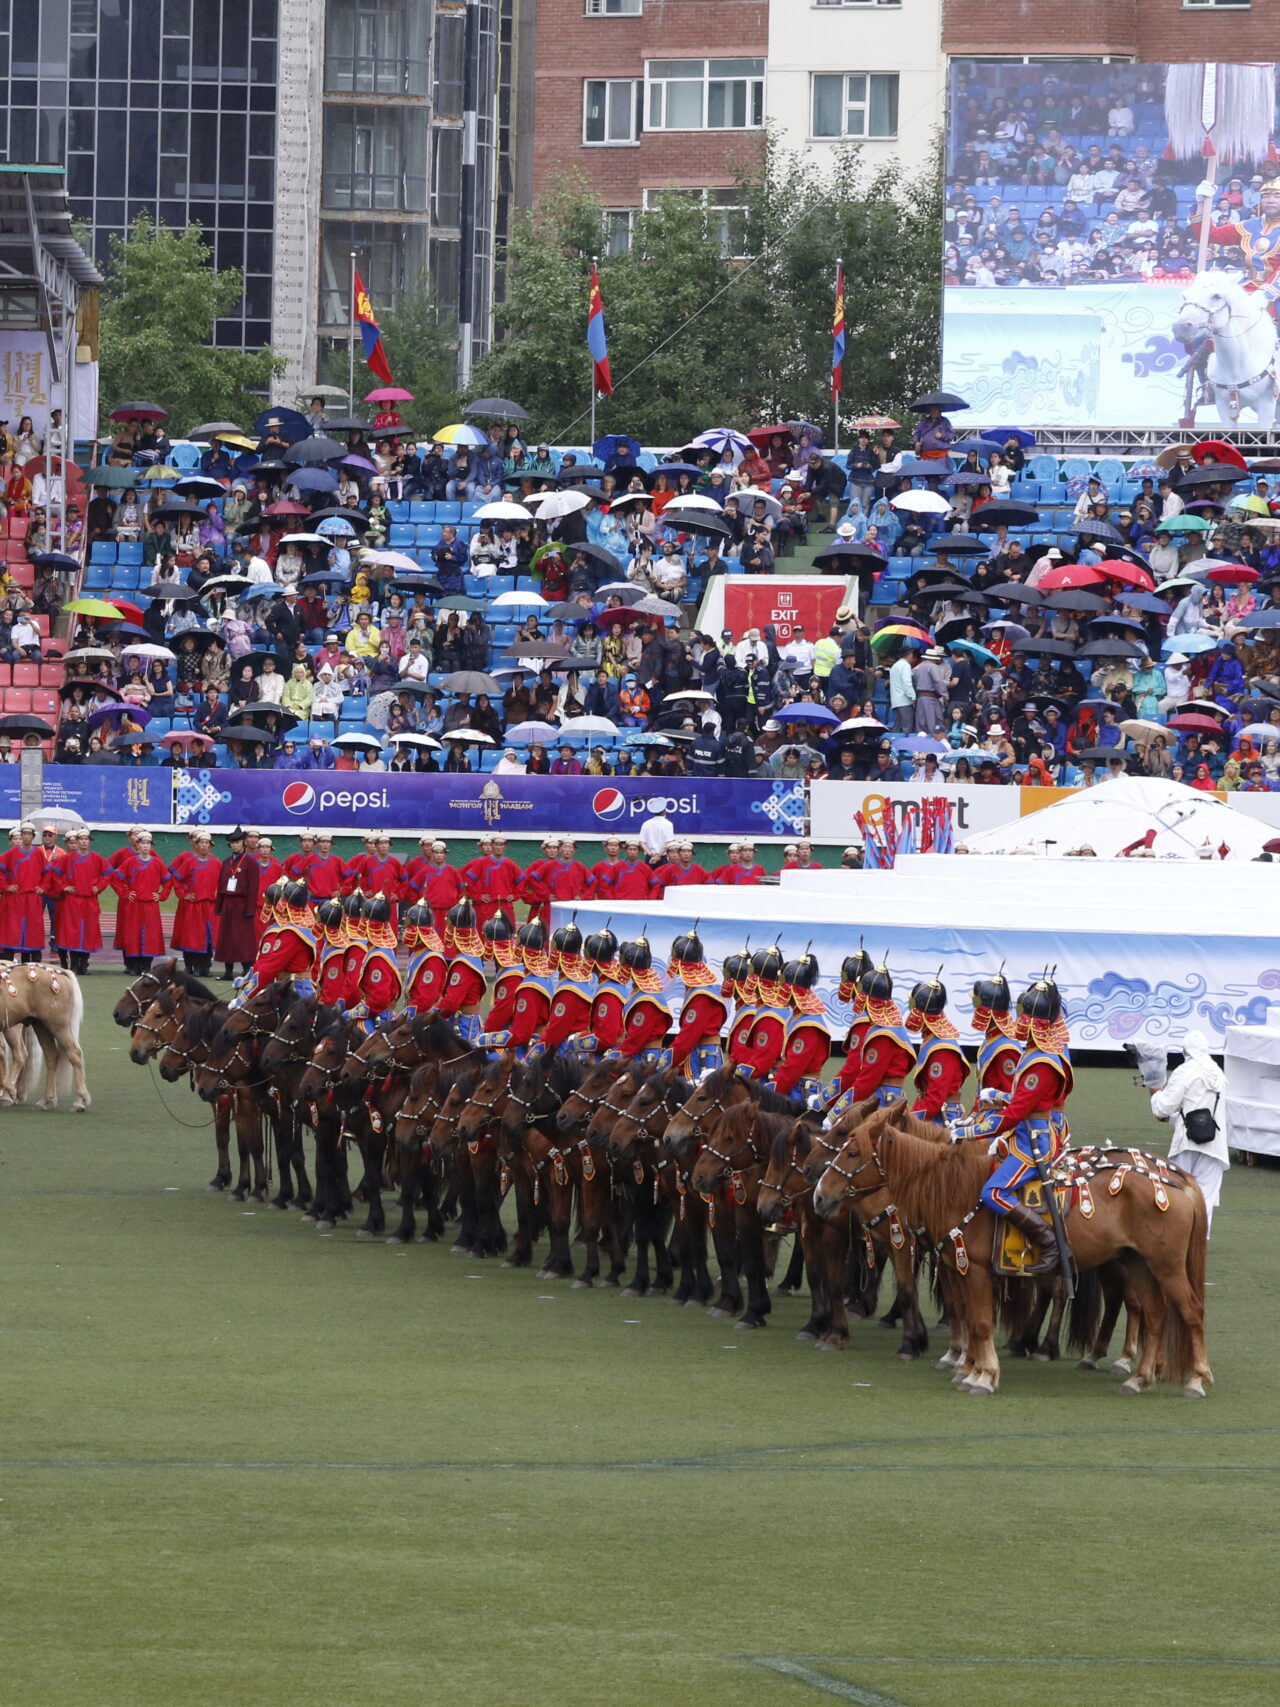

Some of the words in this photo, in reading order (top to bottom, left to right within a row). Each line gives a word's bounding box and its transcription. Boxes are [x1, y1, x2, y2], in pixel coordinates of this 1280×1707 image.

[771, 610, 798, 620] EXIT
[782, 626, 788, 635] 6
[320, 788, 388, 812] pepsi
